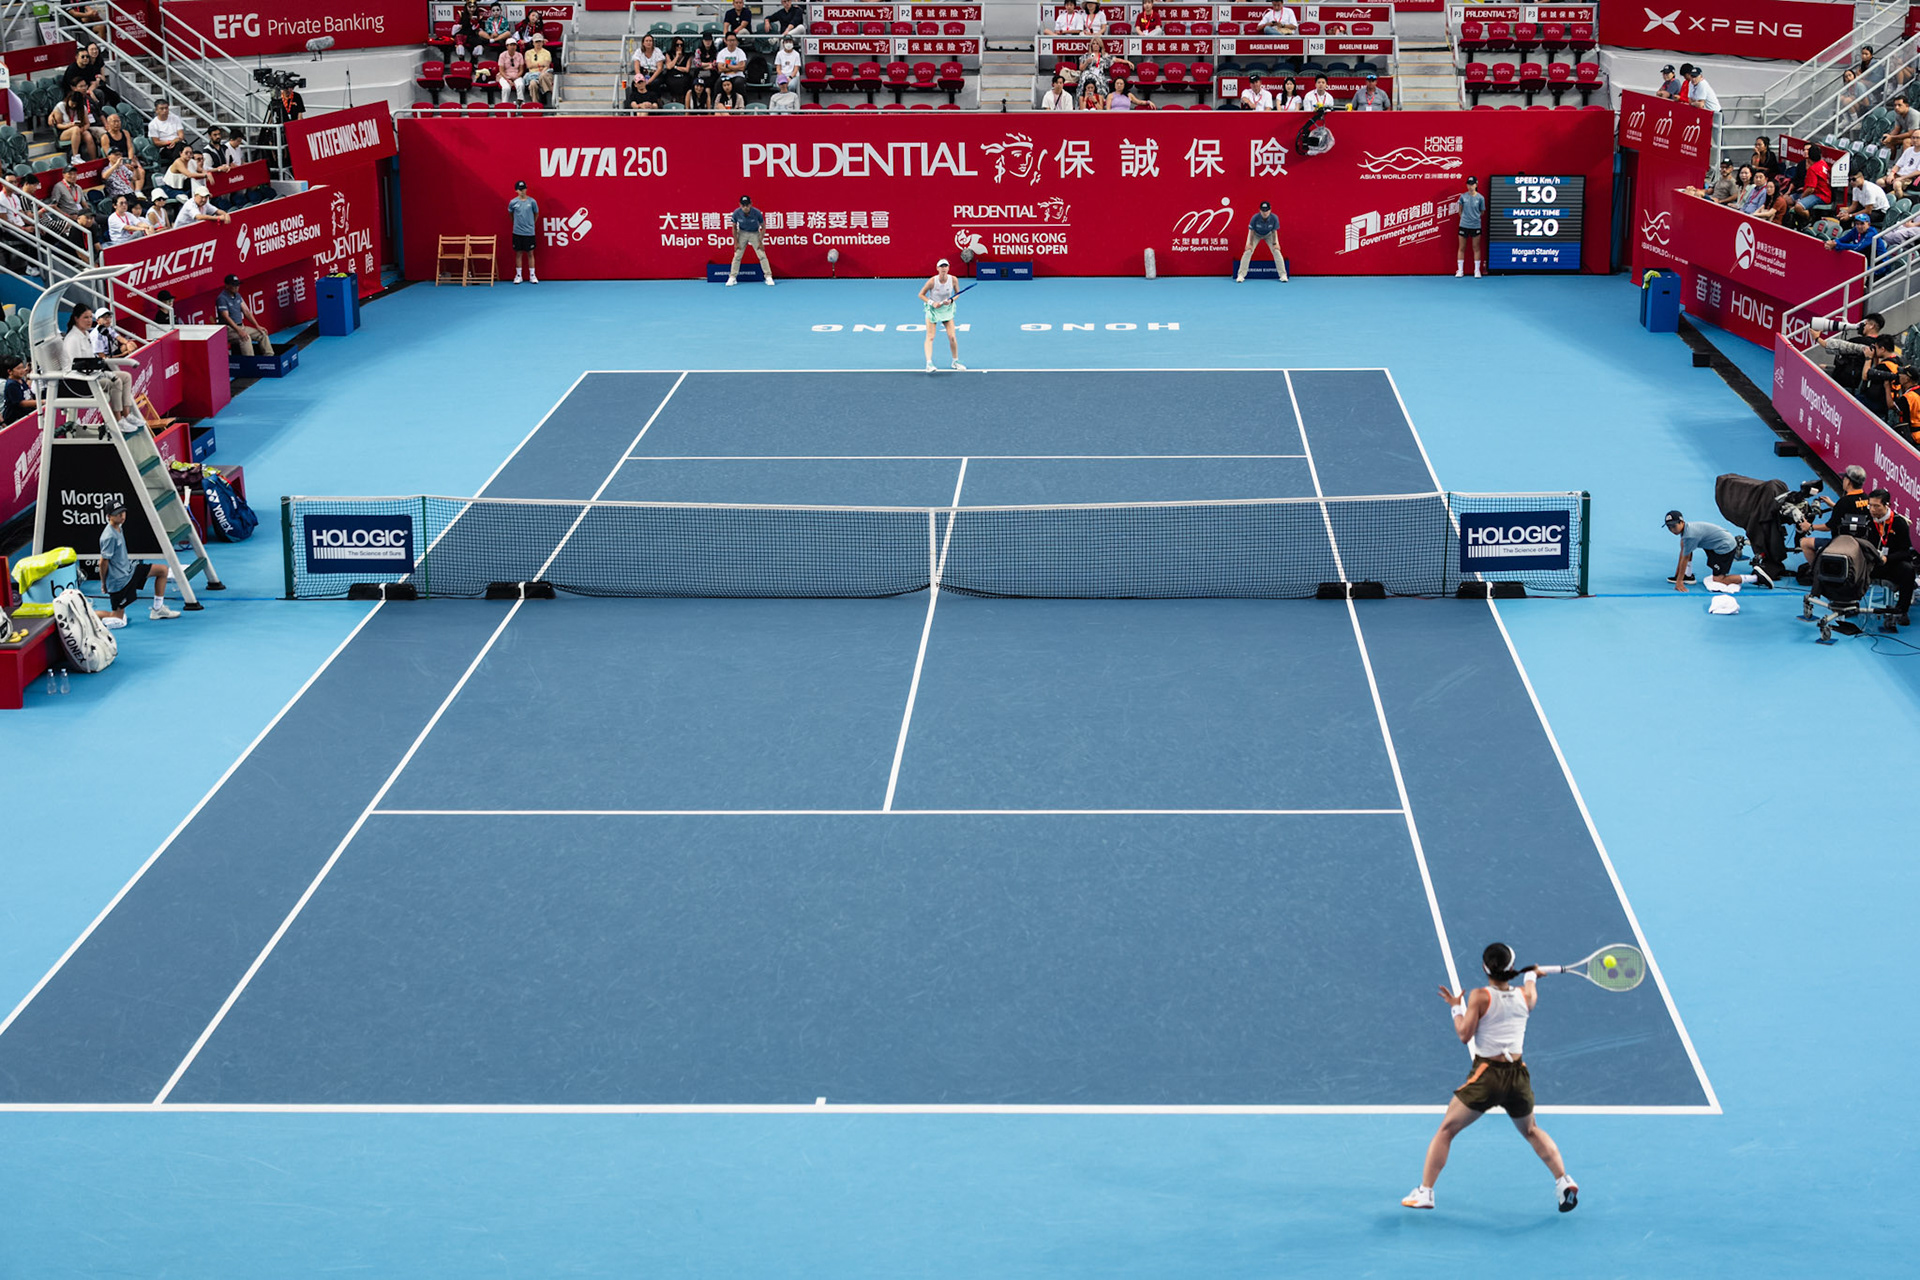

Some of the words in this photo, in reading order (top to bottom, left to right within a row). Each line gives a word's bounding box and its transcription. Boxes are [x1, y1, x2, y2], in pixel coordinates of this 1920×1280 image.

[828, 9, 876, 18] PRUDENTIAL
[213, 13, 260, 39] EFG
[268, 18, 321, 36] Private
[324, 13, 384, 34] Banking
[1688, 16, 1802, 38] XPENG
[822, 42, 872, 51] PRUDENTIAL
[1056, 42, 1088, 50] PRUDEN
[306, 118, 380, 161] WTATENNIS.COM
[1424, 136, 1455, 144] HONG
[540, 147, 617, 178] WTA
[623, 146, 668, 177] 250
[742, 142, 978, 178] PRUDENTIAL
[1054, 137, 1289, 178] 保誠保險
[1540, 176, 1560, 185] Km/h
[1517, 186, 1557, 203] 130
[659, 211, 890, 230] 大型體育動事務委員會
[953, 205, 1038, 218] PRUDENTIAL
[1383, 201, 1433, 229] 政府資助
[253, 222, 279, 241] HONG
[280, 214, 304, 232] KONG
[543, 217, 569, 231] HK
[1360, 218, 1433, 247] Government-funded
[1512, 219, 1559, 236] 1:20
[254, 234, 286, 256] TENNIS
[287, 224, 321, 246] SEASON
[544, 233, 569, 247] TS
[661, 233, 703, 248] Major
[812, 232, 890, 245] Committee
[993, 233, 1029, 244] HONG
[1032, 233, 1067, 243] KONG
[1399, 226, 1439, 245] programme
[992, 245, 1034, 255] TENNIS
[1036, 245, 1068, 255] OPEN
[1511, 248, 1535, 256] Morgan
[1535, 248, 1559, 256] Stanley
[141, 239, 217, 284] HKCTA
[277, 276, 306, 308] 香港
[1696, 274, 1722, 308] 香港
[1731, 290, 1774, 330] HONG
[1020, 323, 1180, 332] HONG
[1801, 376, 1820, 411] Morgan
[1821, 394, 1842, 436] Stanley
[1874, 442, 1899, 484] Morgan
[1899, 464, 1920, 502] Stanle
[61, 490, 124, 509] Morgan
[213, 504, 234, 533] YONEX
[64, 633, 86, 663] YONEX
